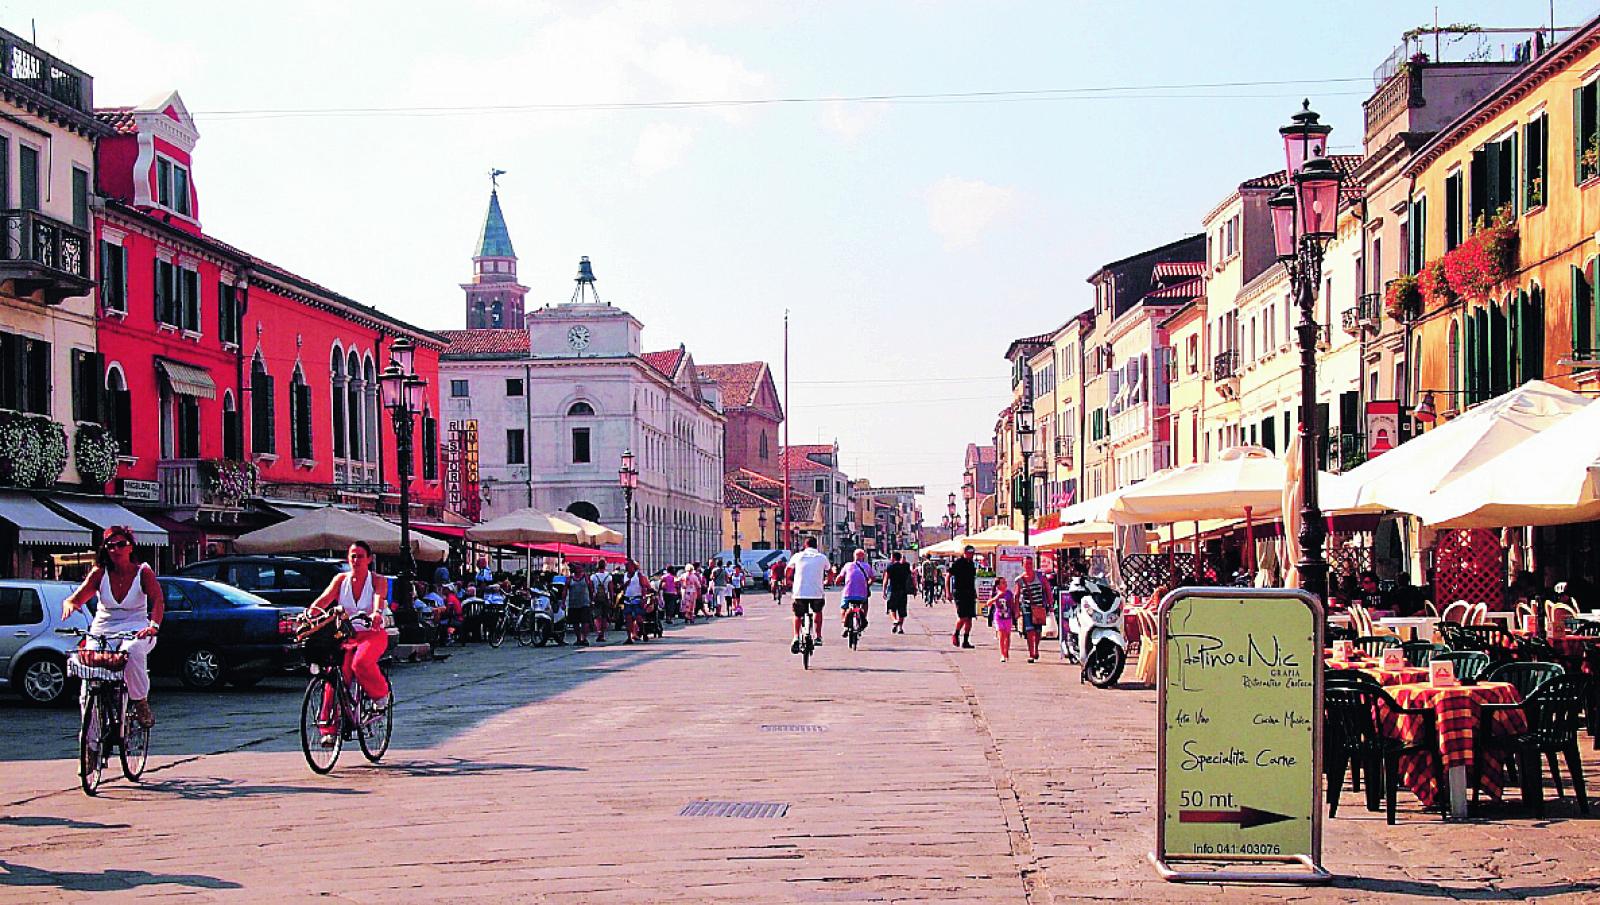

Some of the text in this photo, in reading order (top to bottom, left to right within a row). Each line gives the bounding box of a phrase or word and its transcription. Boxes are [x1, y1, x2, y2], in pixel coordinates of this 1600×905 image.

[467, 420, 479, 482] ANTICO
[1247, 633, 1298, 667] Nic
[1256, 749, 1297, 767] Carne
[1179, 790, 1238, 808] 50 mt.
[1194, 843, 1280, 855] Info 041 403076
